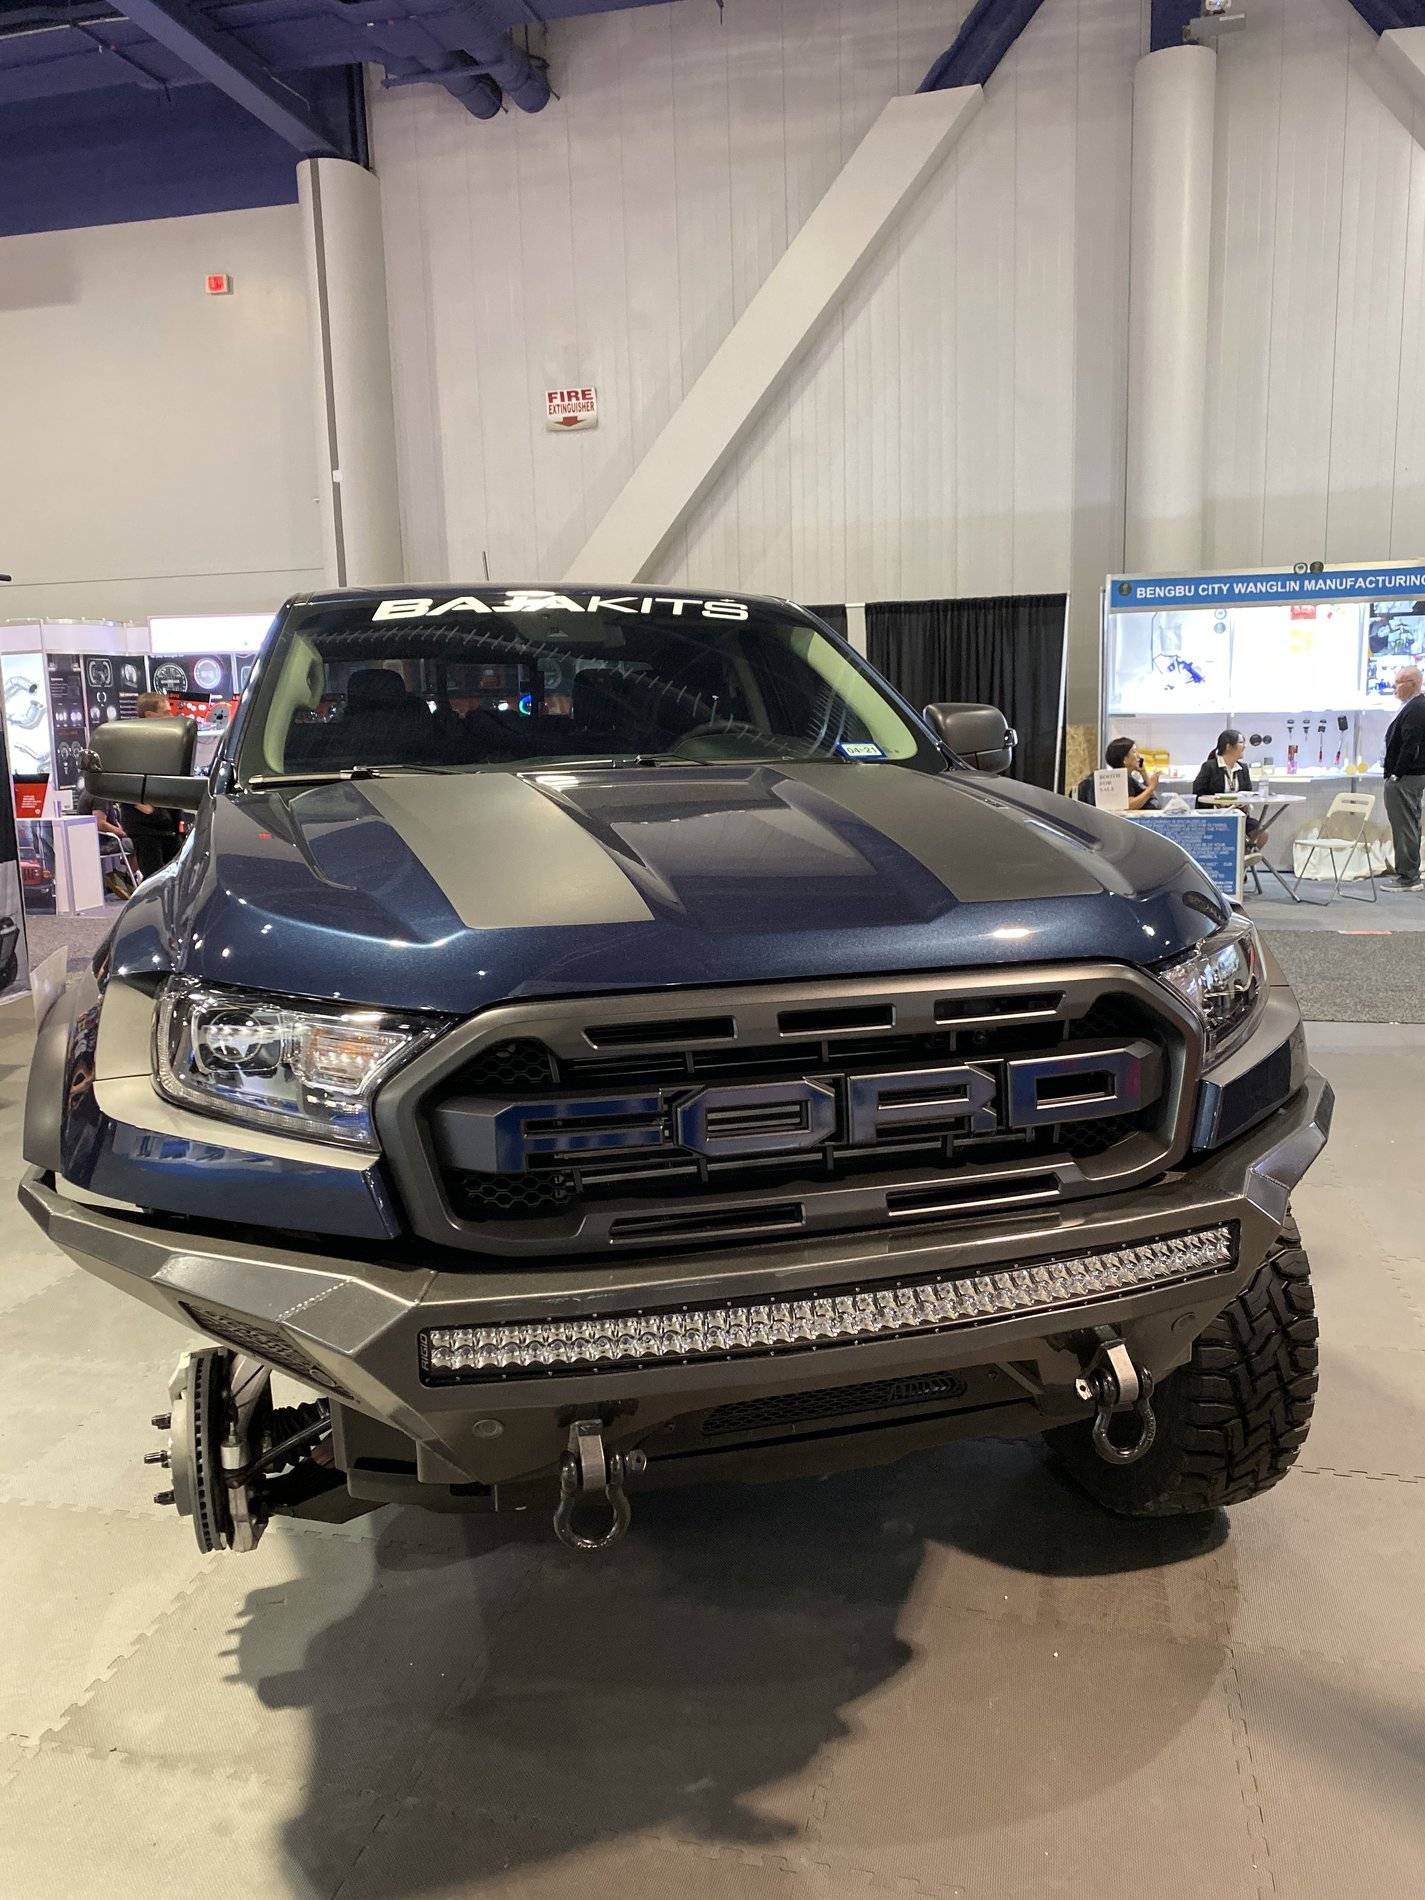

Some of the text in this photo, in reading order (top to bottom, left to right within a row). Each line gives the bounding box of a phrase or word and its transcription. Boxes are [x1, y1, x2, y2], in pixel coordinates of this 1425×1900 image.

[547, 389, 593, 403] FIRE
[548, 401, 594, 415] EXTINGUISHER
[1136, 585, 1194, 598] BENGBU
[1199, 584, 1229, 596] CITY
[1233, 580, 1299, 594] WANGLIN
[436, 1042, 1158, 1175] FORD
[420, 1333, 429, 1371] RIGID
